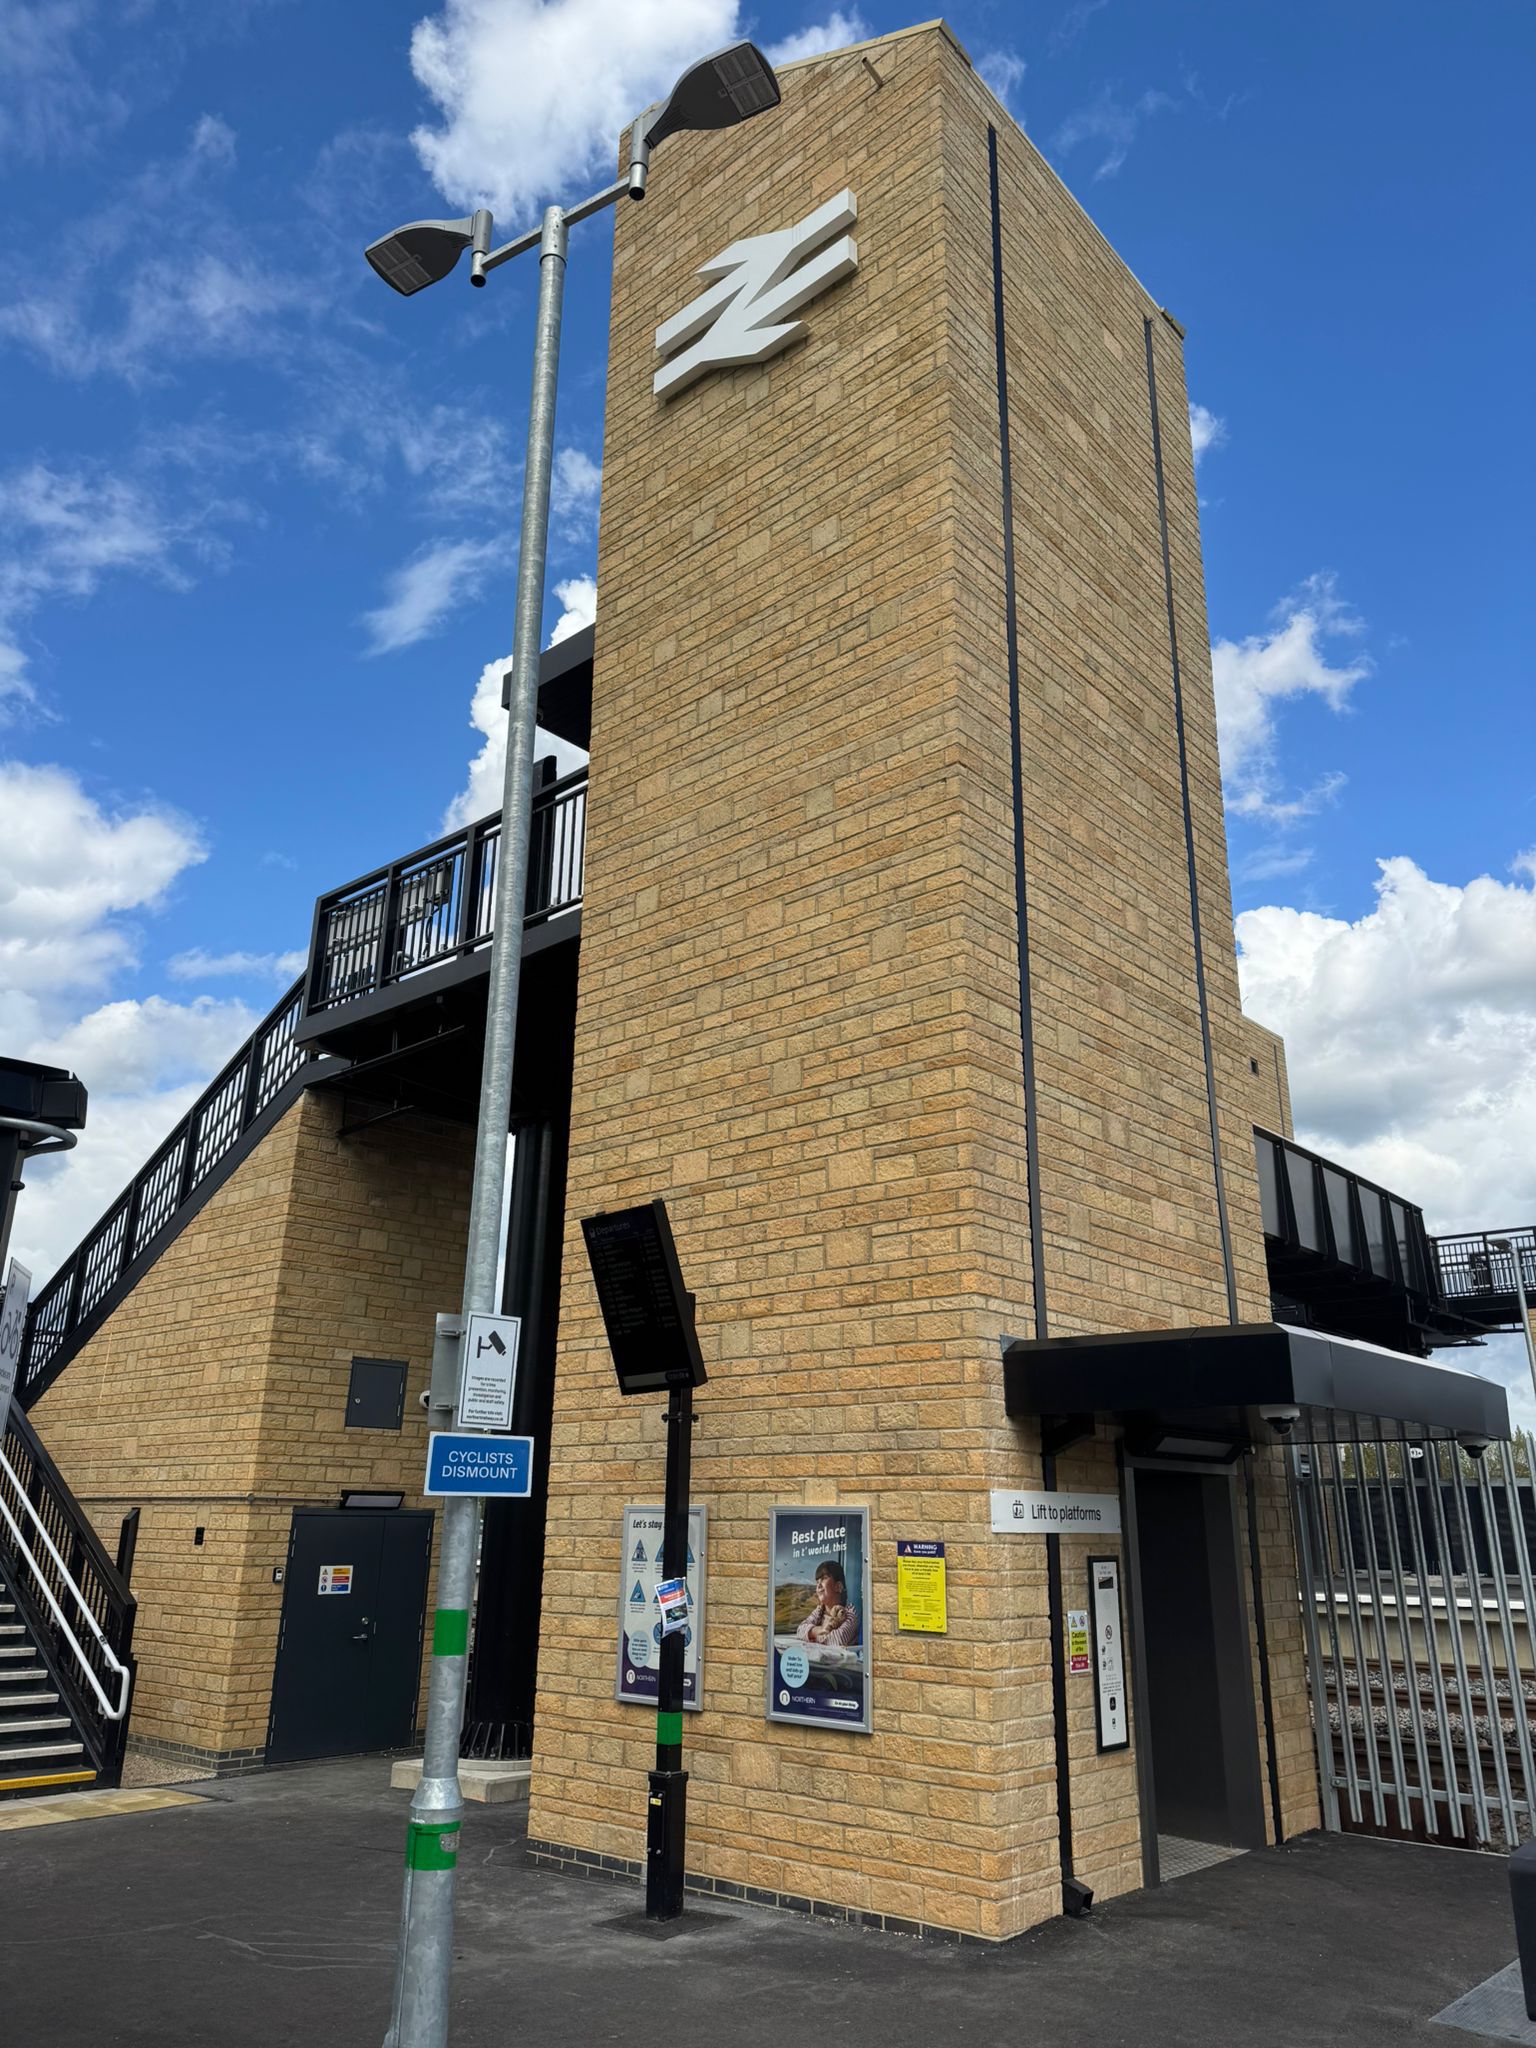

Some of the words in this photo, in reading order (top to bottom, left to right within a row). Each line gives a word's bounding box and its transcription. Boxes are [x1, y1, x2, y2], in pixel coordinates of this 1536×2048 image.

[448, 1450, 514, 1464] CYCLISTS
[442, 1466, 518, 1479] DISMOUNT
[1032, 1504, 1047, 1520] Lift
[1048, 1505, 1058, 1520] to
[1060, 1505, 1102, 1522] platforms
[632, 1520, 647, 1528] Let's
[648, 1520, 662, 1530] stay
[792, 1529, 814, 1545] Best
[817, 1526, 846, 1544] place
[792, 1548, 800, 1558] in
[832, 1540, 847, 1552] this
[792, 1696, 816, 1704] NORTHERN
